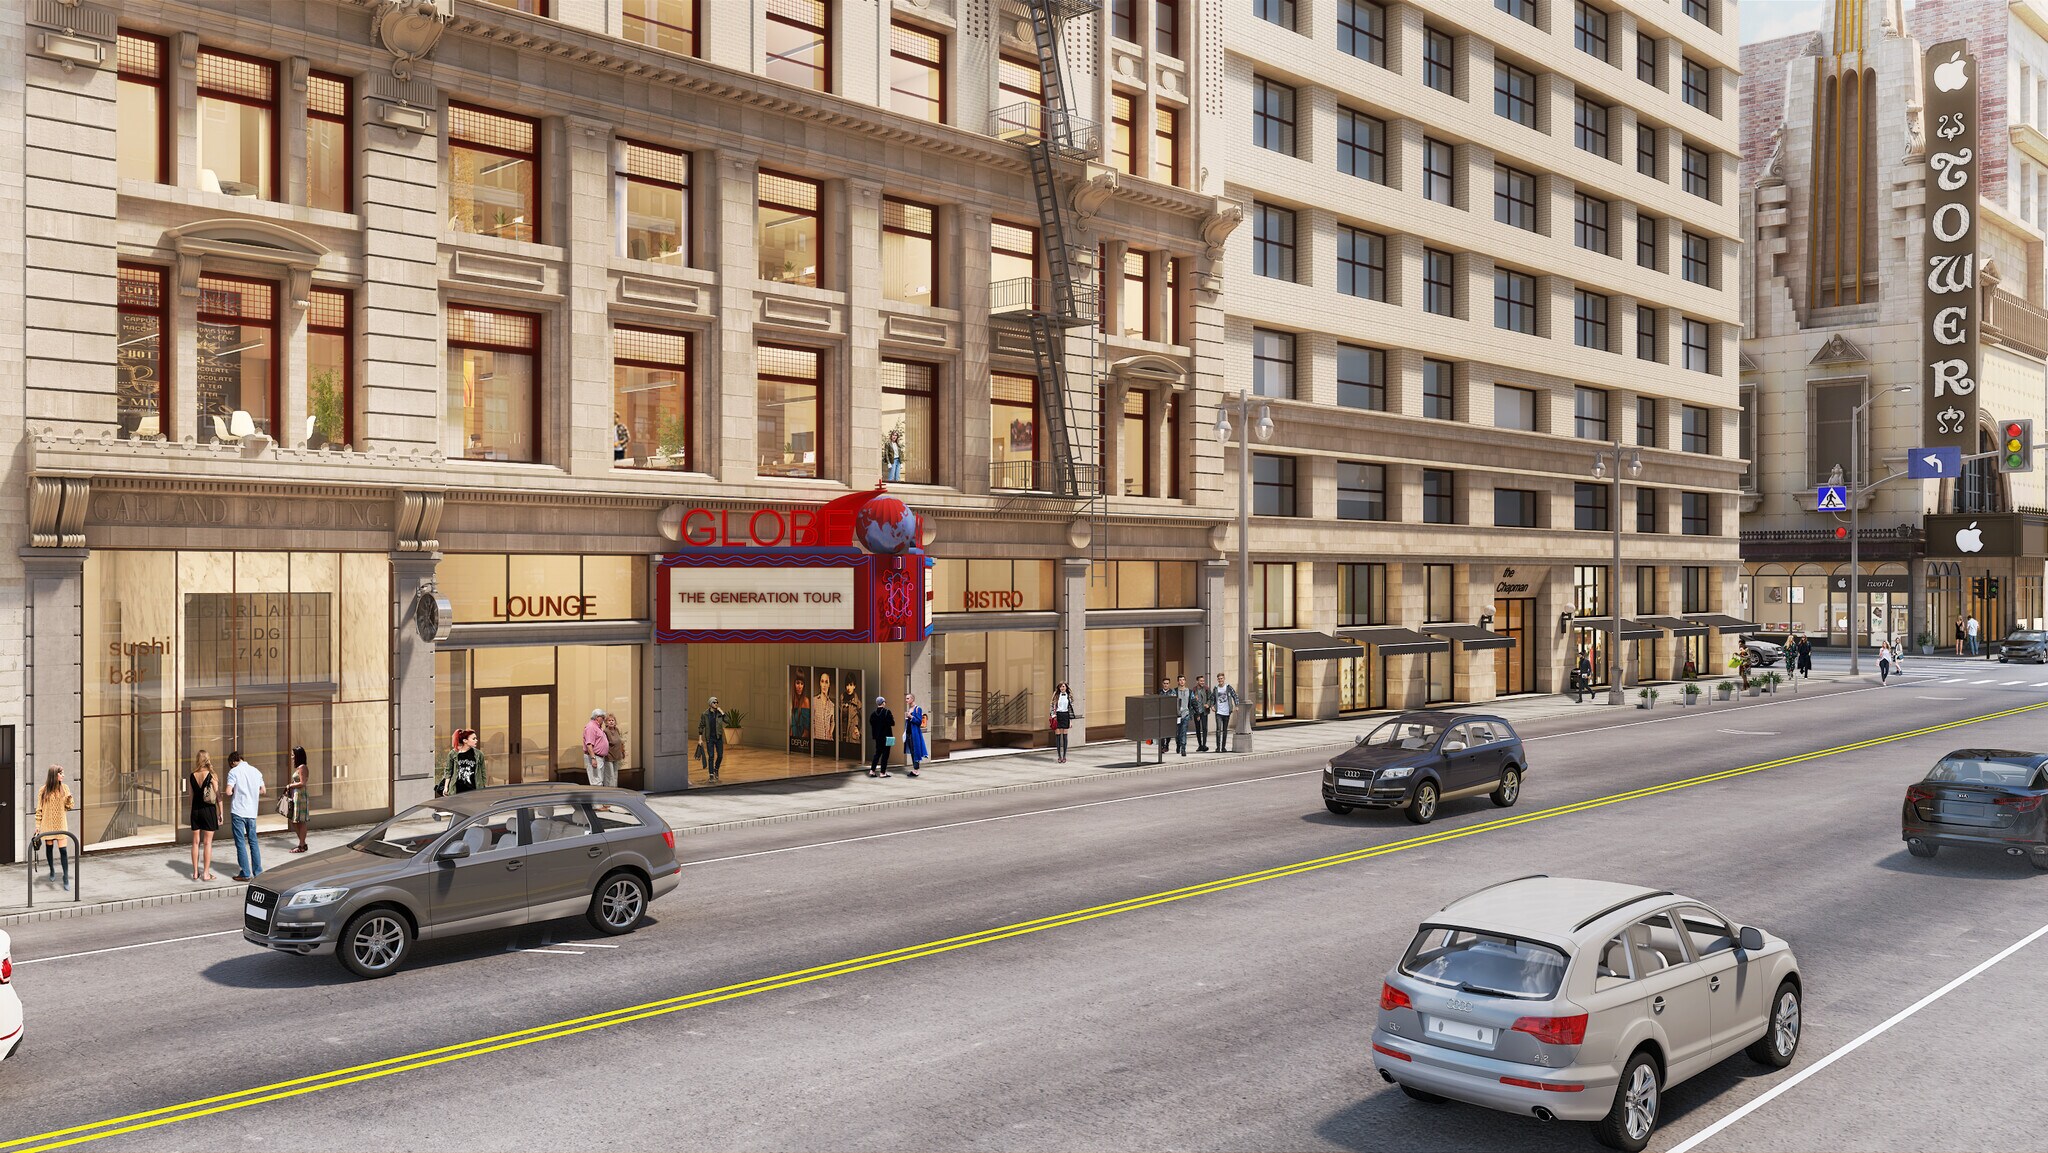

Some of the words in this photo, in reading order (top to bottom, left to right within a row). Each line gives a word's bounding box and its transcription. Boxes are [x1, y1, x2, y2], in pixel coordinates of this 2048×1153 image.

[1927, 147, 1975, 398] TOWER
[93, 494, 228, 523] GARLAND
[681, 507, 854, 547] GLOBE
[1502, 567, 1515, 578] the
[1496, 581, 1529, 595] Chapman
[493, 595, 598, 618] LOUNGE
[678, 592, 705, 604] THE
[710, 592, 799, 604] GENERATION
[803, 592, 842, 604] TOUR
[963, 590, 1024, 609] BISTRO
[221, 627, 281, 641] BLDG
[109, 636, 170, 656] sushi
[238, 646, 279, 660] 740
[110, 665, 147, 685] bar
